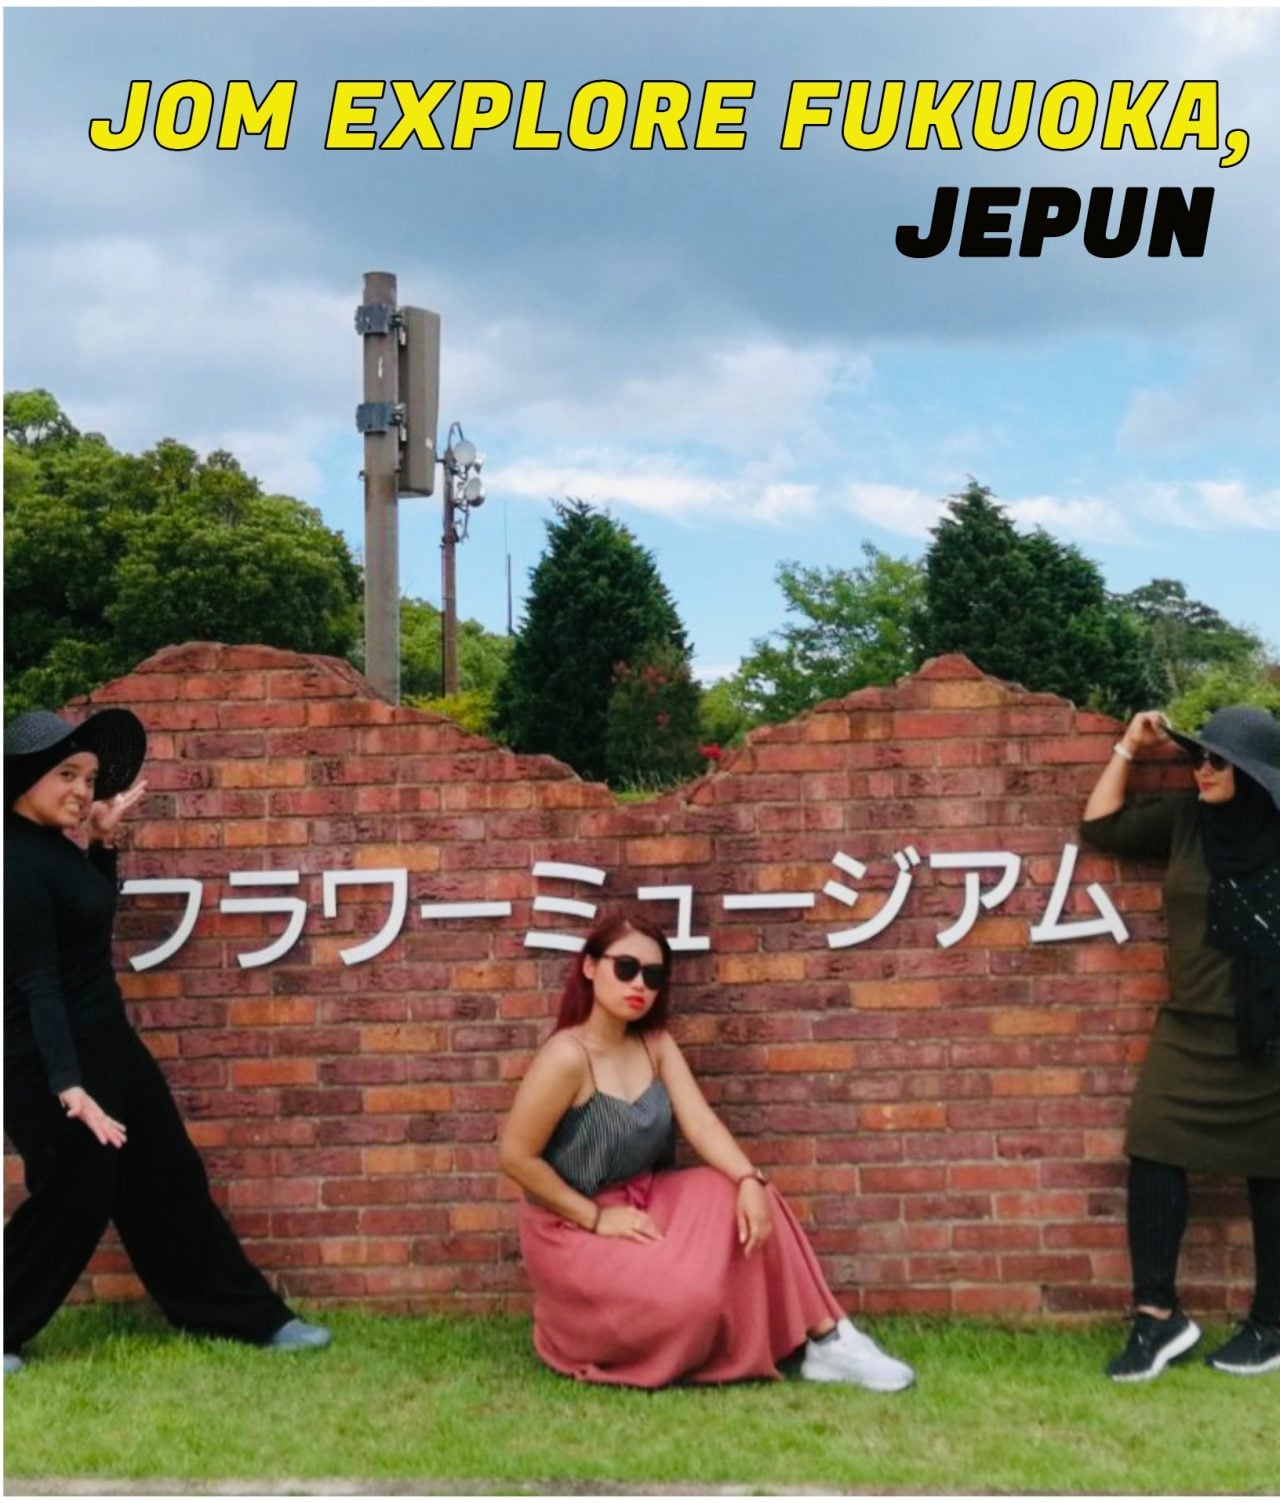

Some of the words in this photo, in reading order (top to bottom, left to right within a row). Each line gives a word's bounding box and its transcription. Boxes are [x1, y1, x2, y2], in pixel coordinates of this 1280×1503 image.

[122, 842, 1129, 972] フラワーミュージアム
